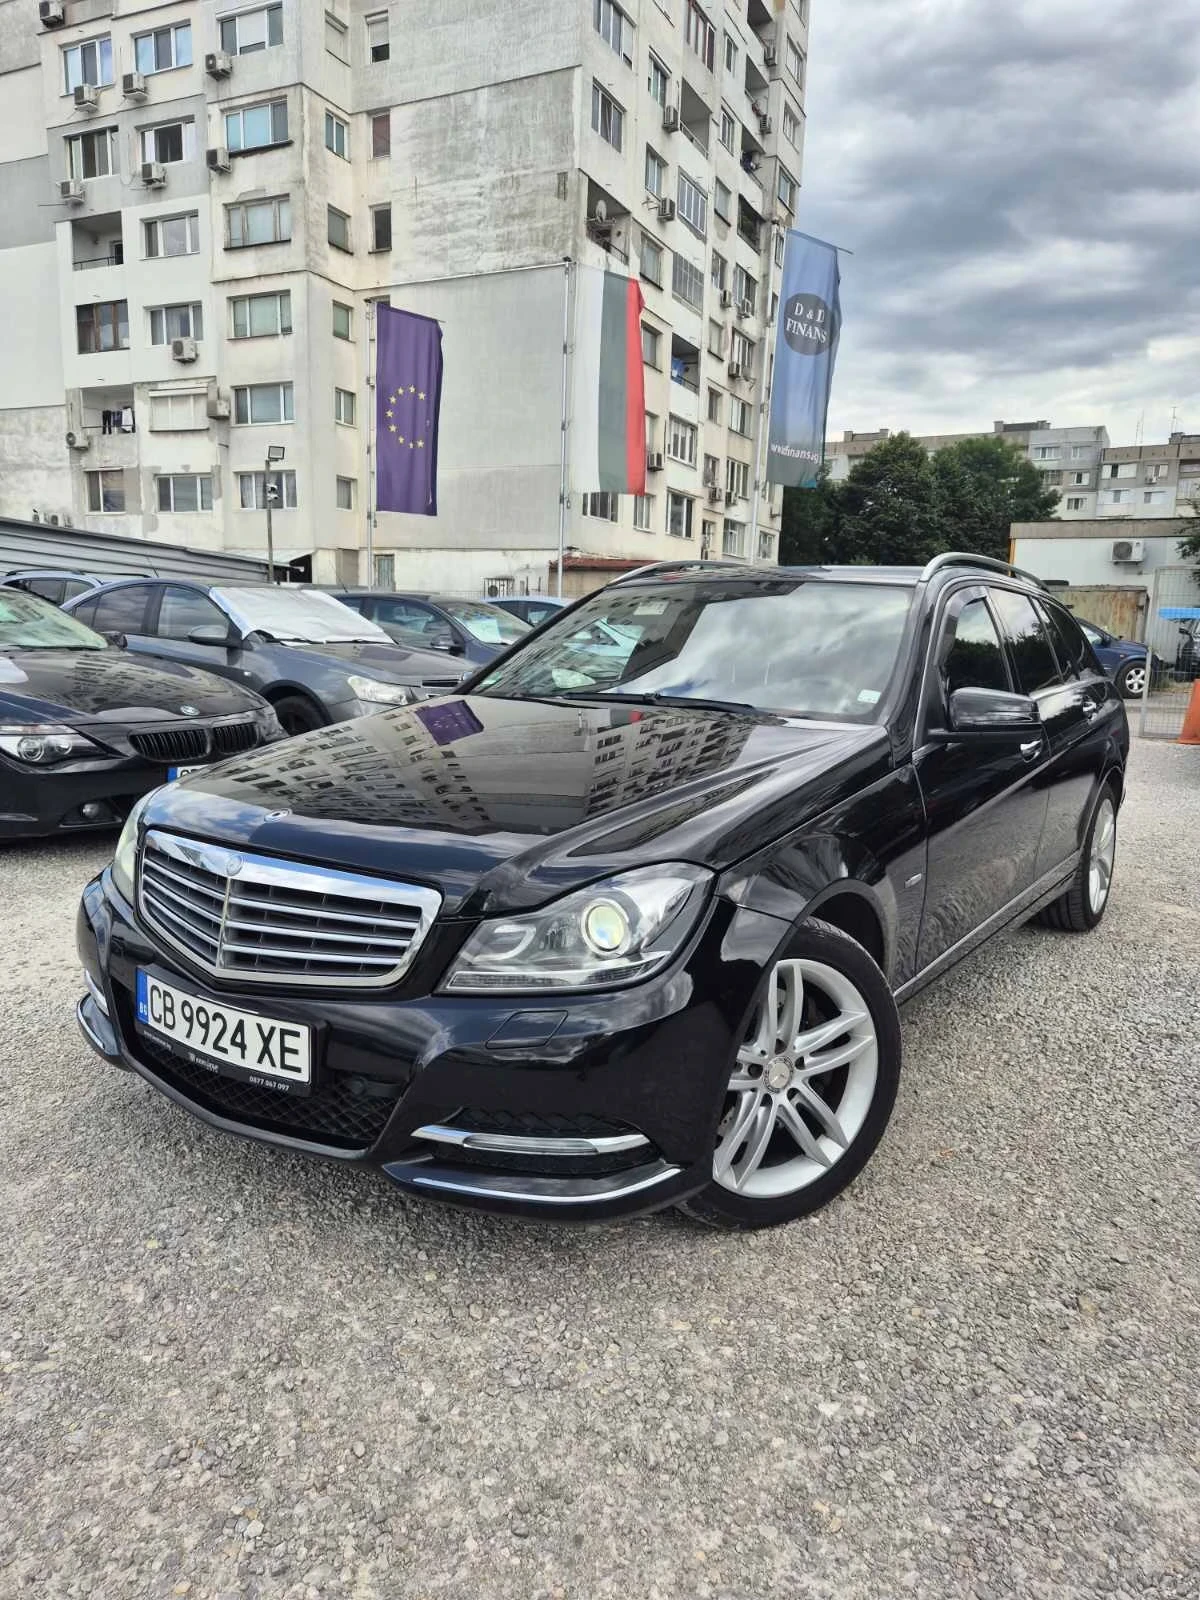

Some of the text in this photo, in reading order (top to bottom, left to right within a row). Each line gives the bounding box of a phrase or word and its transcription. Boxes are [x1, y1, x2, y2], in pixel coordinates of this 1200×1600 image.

[794, 302, 803, 316] D
[806, 310, 814, 320] &
[786, 318, 827, 344] FINANS
[150, 984, 176, 1031] CB
[181, 1000, 247, 1060] 9924
[256, 1022, 302, 1074] XE
